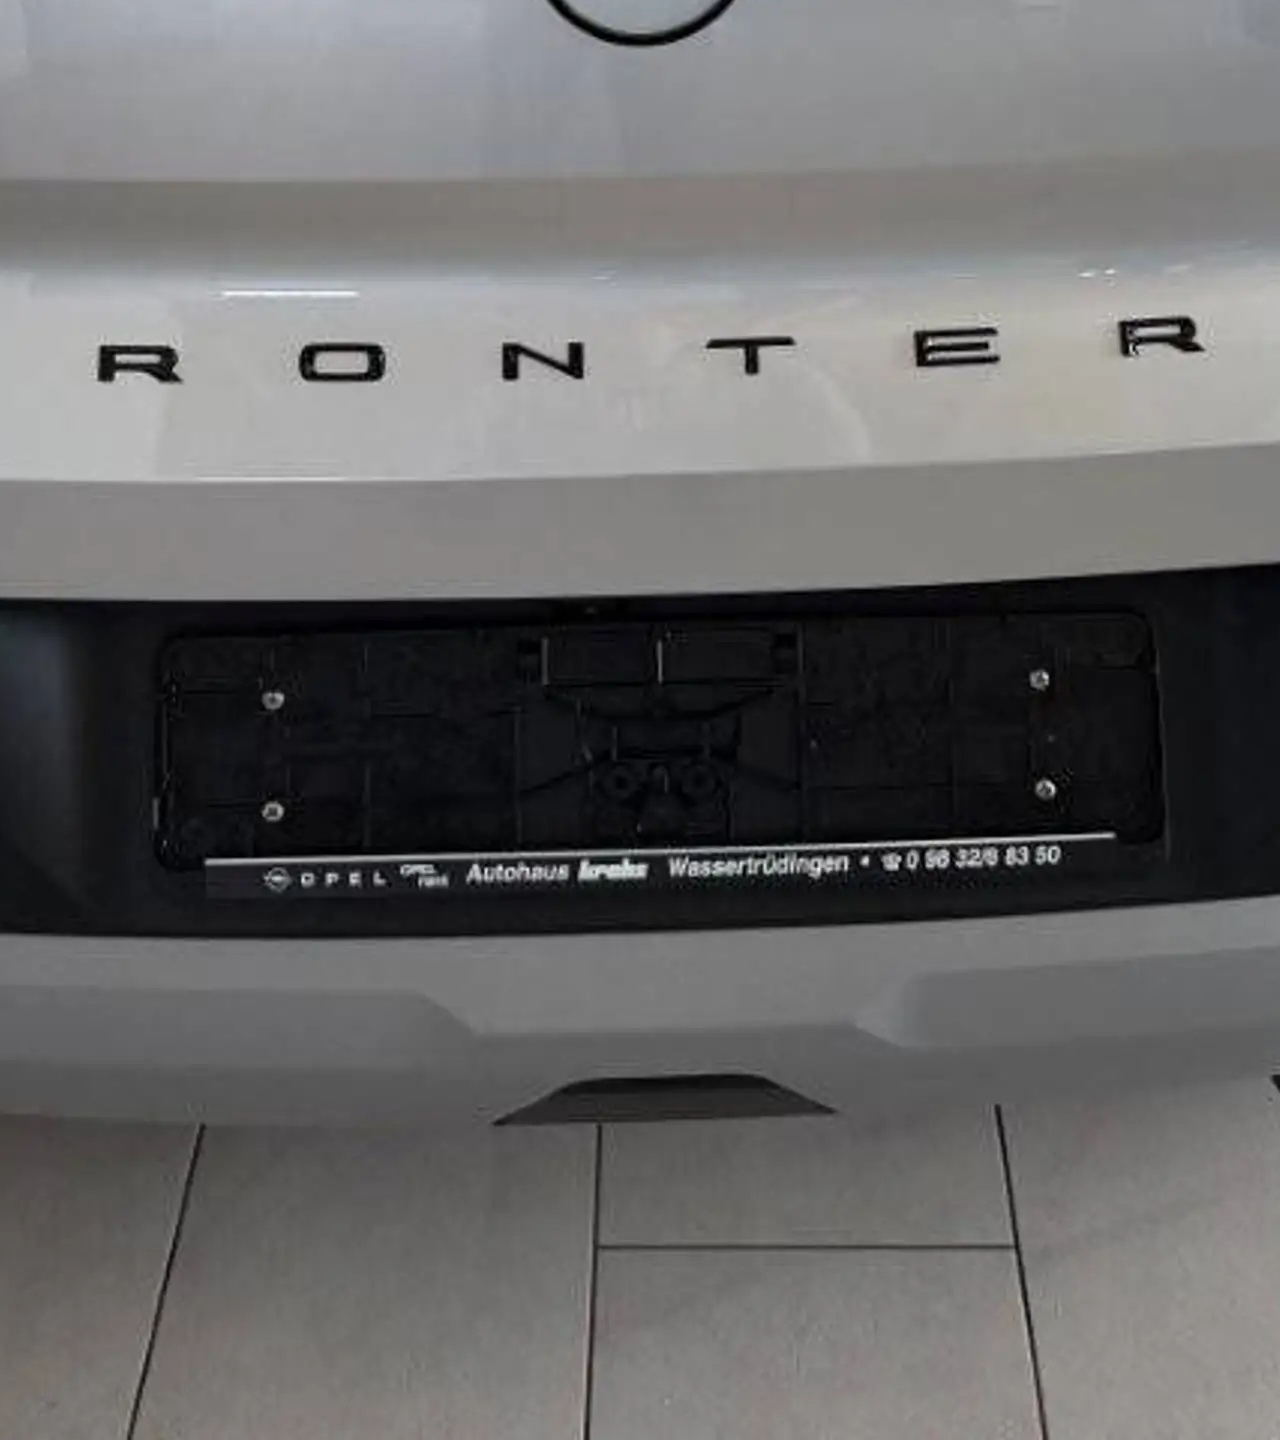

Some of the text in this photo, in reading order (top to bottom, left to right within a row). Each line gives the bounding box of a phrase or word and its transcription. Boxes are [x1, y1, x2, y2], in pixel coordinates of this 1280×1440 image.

[300, 870, 388, 888] OPEL
[467, 862, 570, 884] Autohaus
[669, 852, 850, 879] Wassertrüdingen
